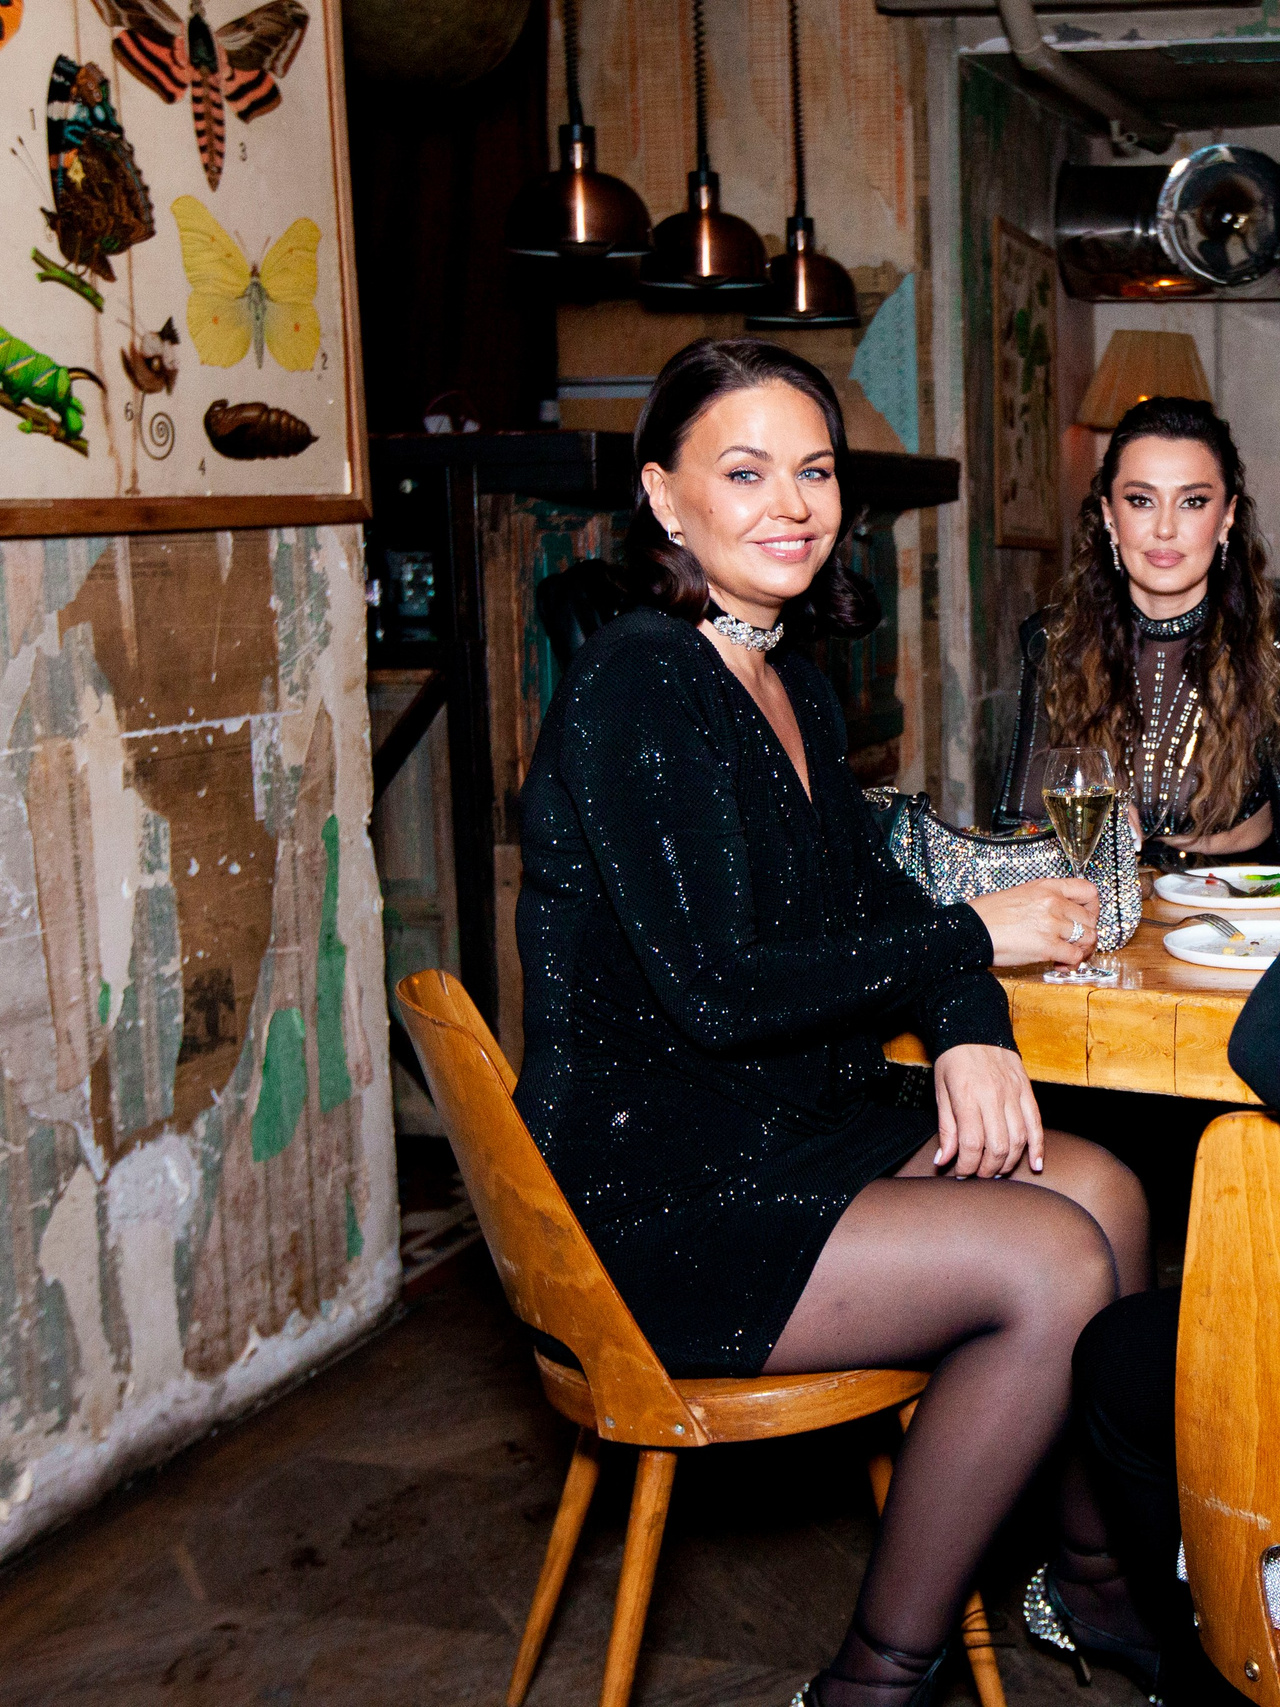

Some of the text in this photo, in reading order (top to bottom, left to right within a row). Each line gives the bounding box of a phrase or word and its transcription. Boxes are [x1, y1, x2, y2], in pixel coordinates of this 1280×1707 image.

[239, 142, 248, 161] 3
[321, 352, 328, 371] 2
[124, 401, 134, 422] 6
[197, 457, 206, 477] 4
